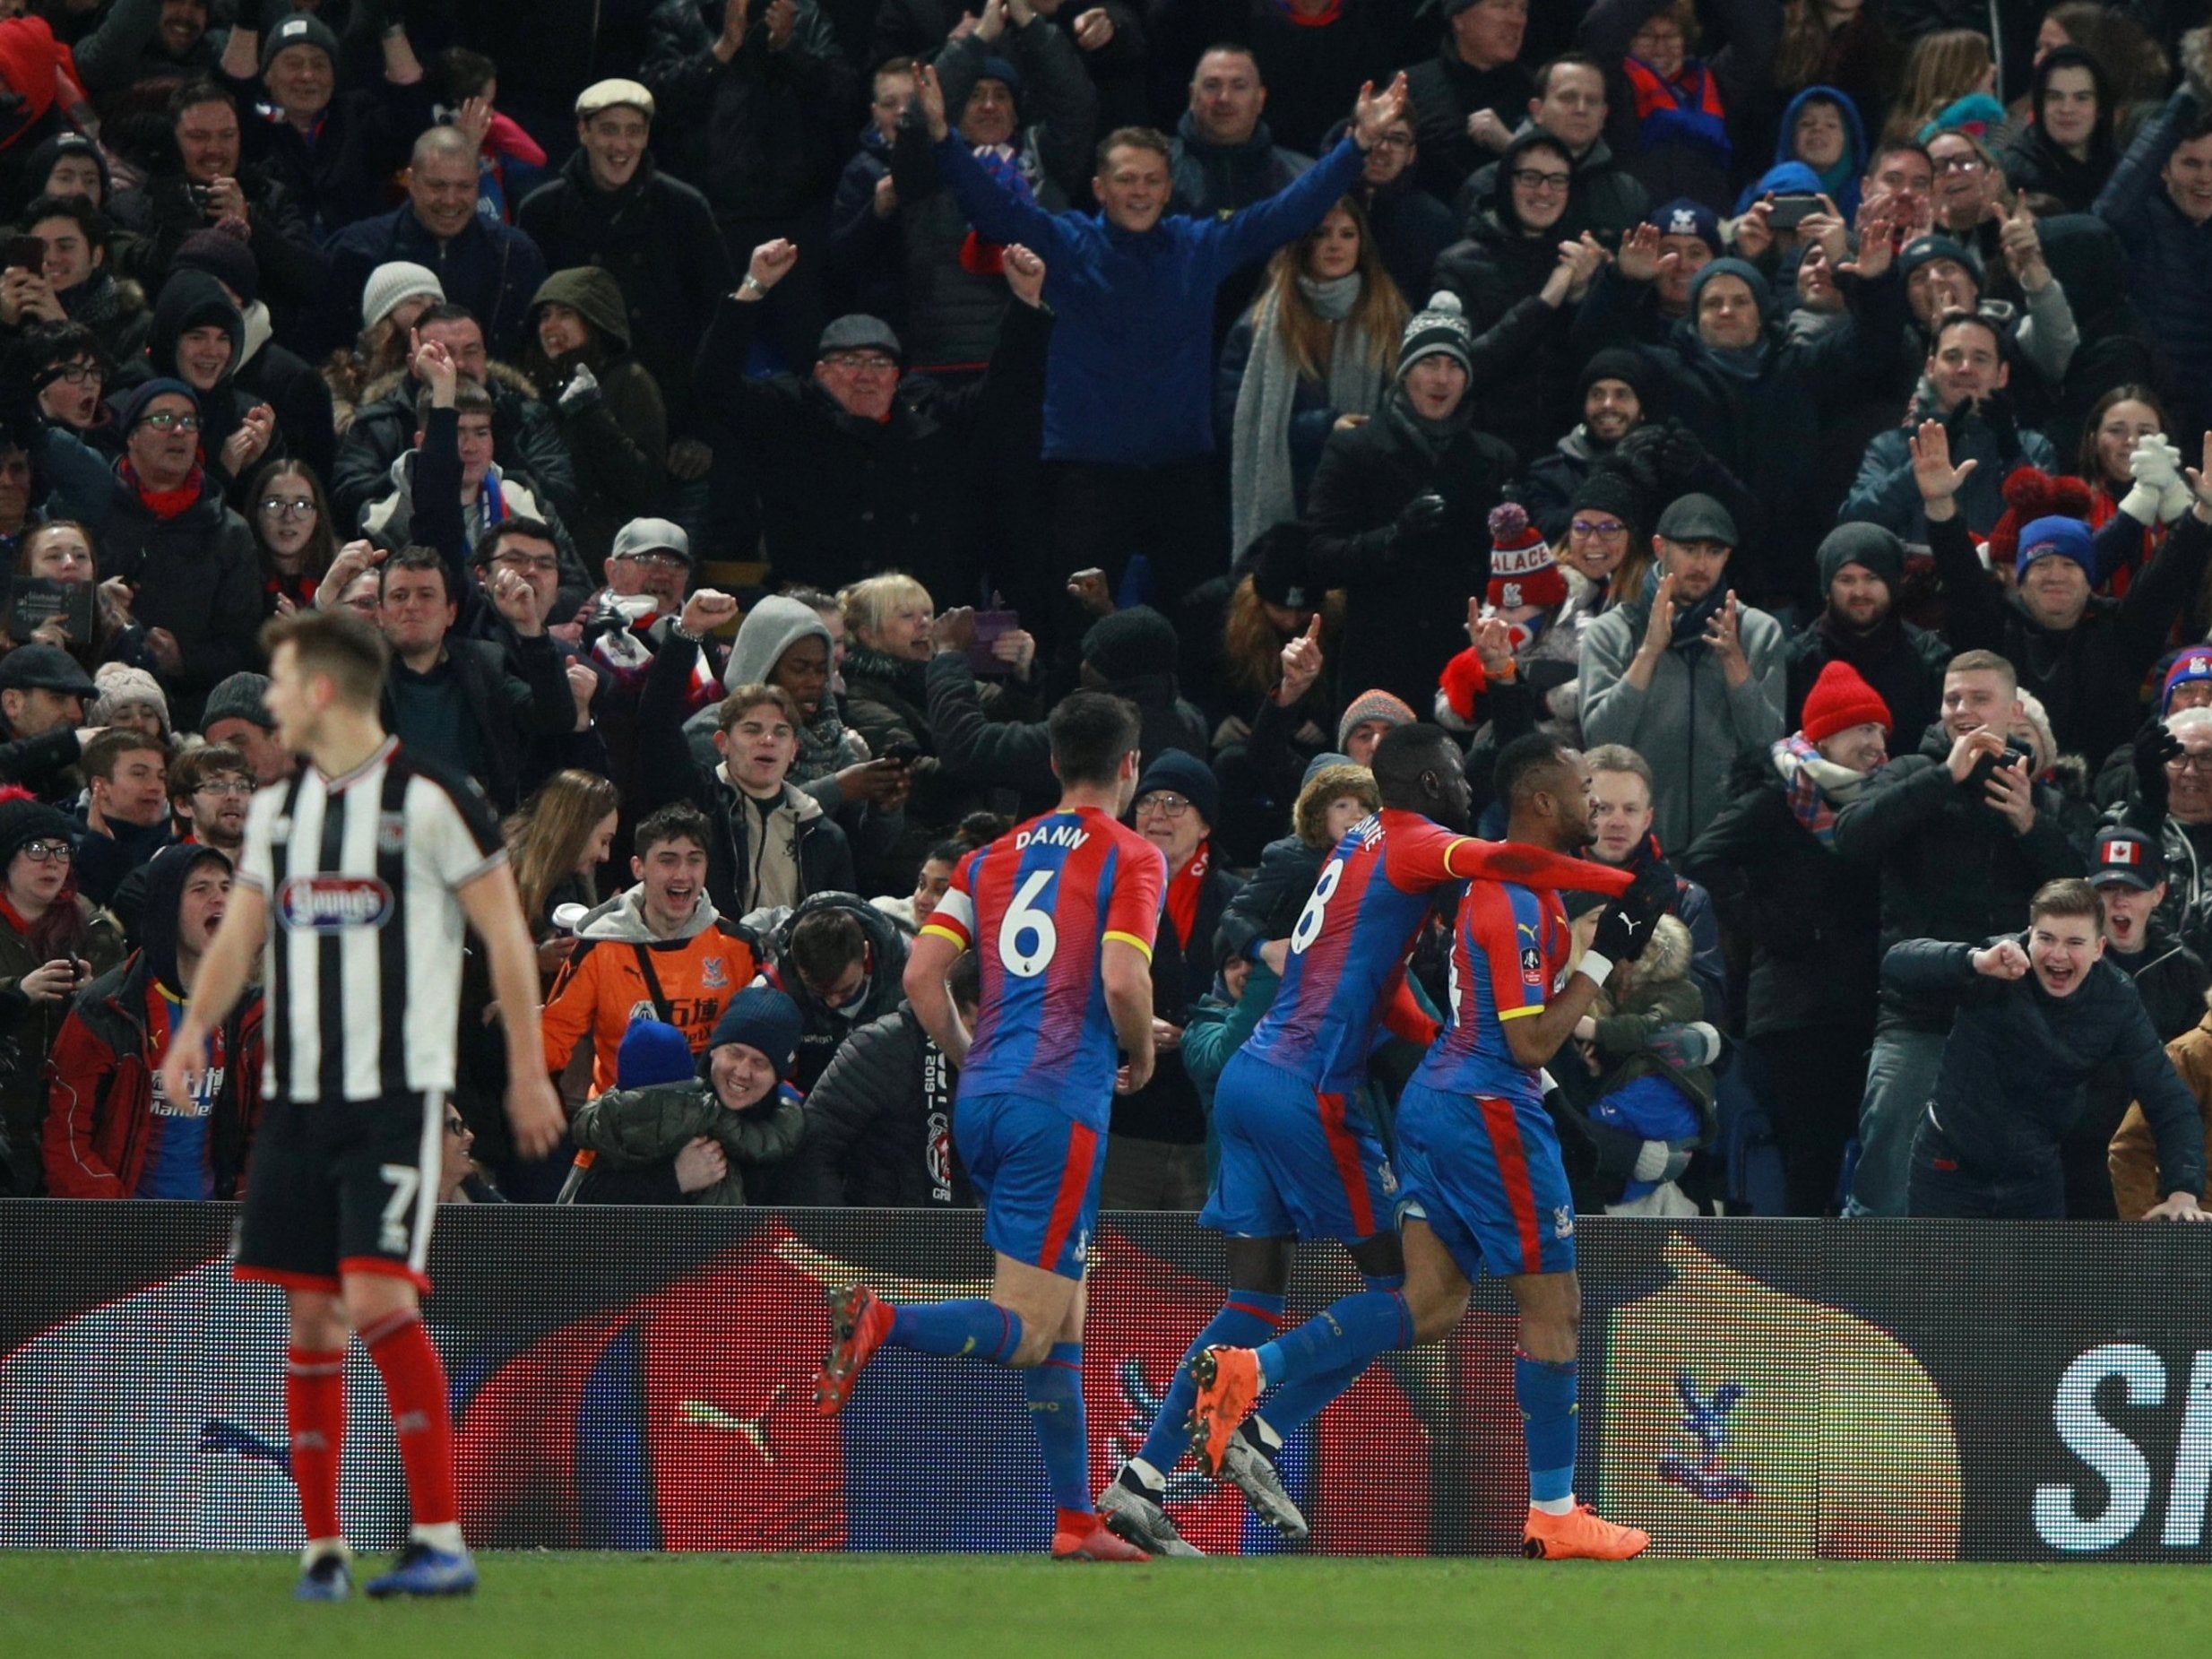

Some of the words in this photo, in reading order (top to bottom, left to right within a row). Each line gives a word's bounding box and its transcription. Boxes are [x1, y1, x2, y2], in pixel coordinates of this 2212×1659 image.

[1015, 825, 1090, 851] DANN
[998, 870, 1057, 978] 6
[1291, 859, 1344, 955] 8
[925, 1055, 936, 1093] 2019
[380, 1164, 419, 1220] 7
